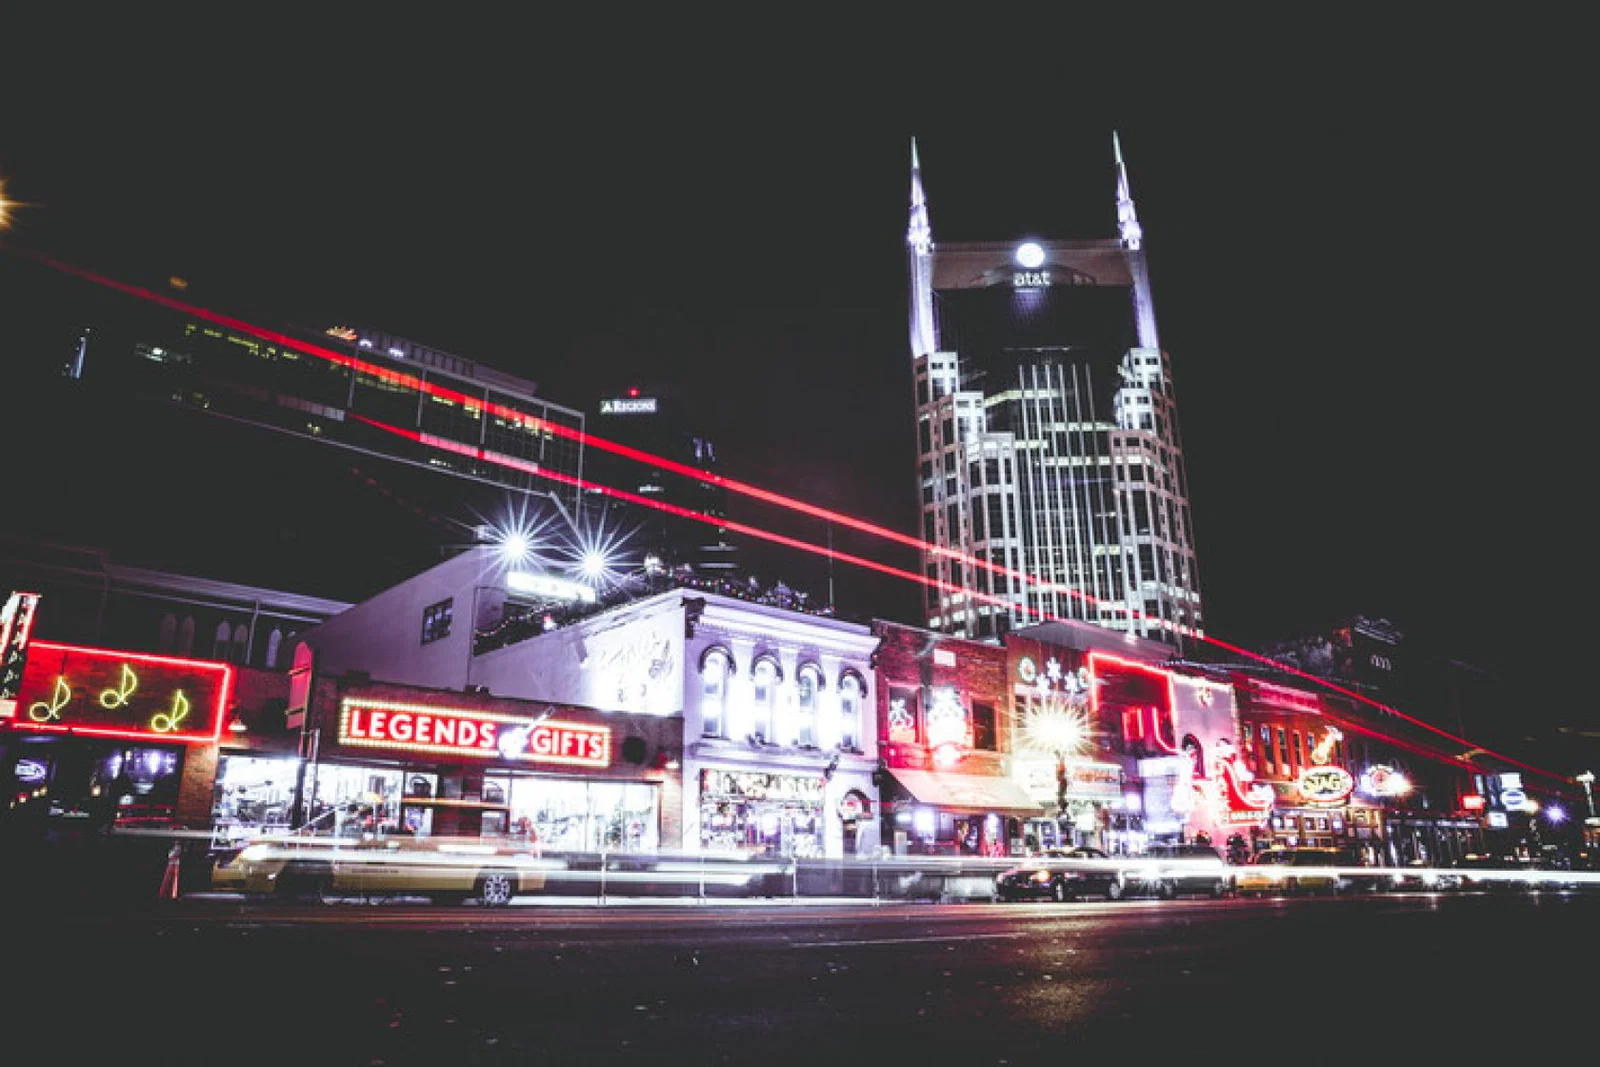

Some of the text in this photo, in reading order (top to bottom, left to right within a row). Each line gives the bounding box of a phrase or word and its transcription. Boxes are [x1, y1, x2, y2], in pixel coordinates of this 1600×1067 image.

[1013, 270, 1051, 287] at&t
[350, 709, 603, 759] LEGENDS GIFTS
